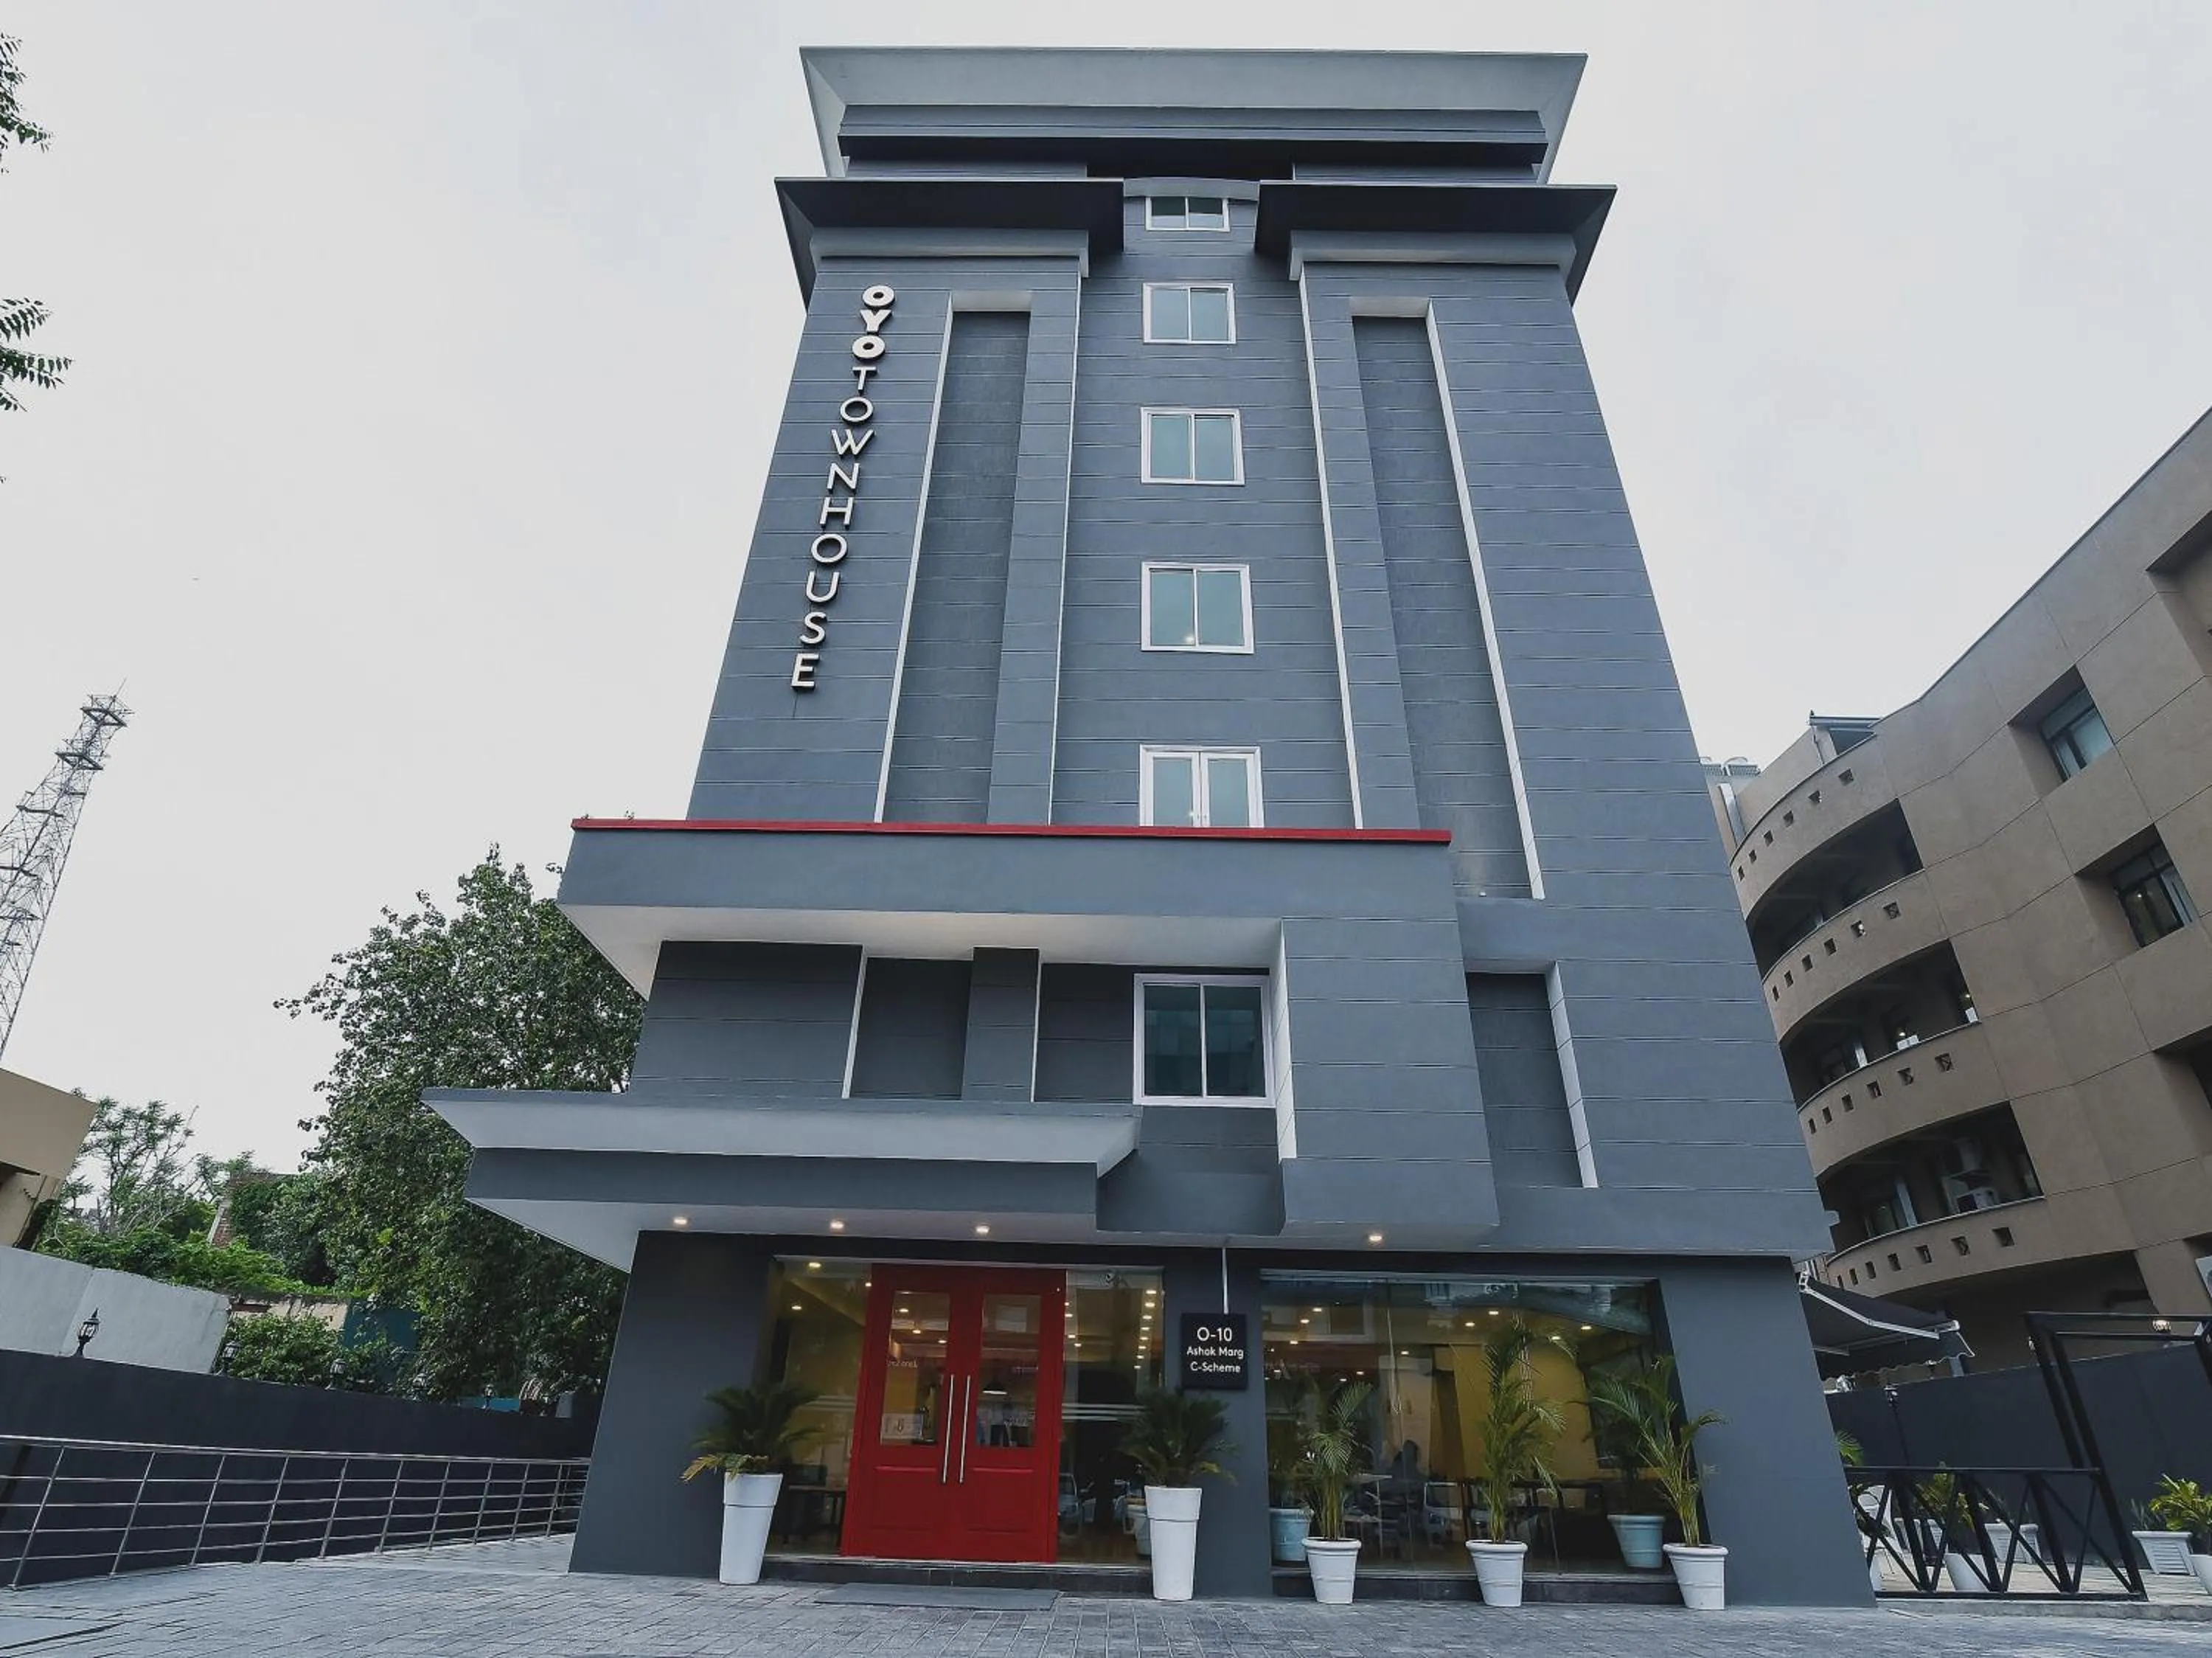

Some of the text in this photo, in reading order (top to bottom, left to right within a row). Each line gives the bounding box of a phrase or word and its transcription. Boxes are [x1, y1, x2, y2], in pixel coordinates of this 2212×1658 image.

[792, 285, 895, 688] OYO TOWNHOUSE
[1197, 1327, 1232, 1342] O-10
[1186, 1346, 1244, 1359] Ashok Marg
[1190, 1361, 1241, 1373] C-Scheme
